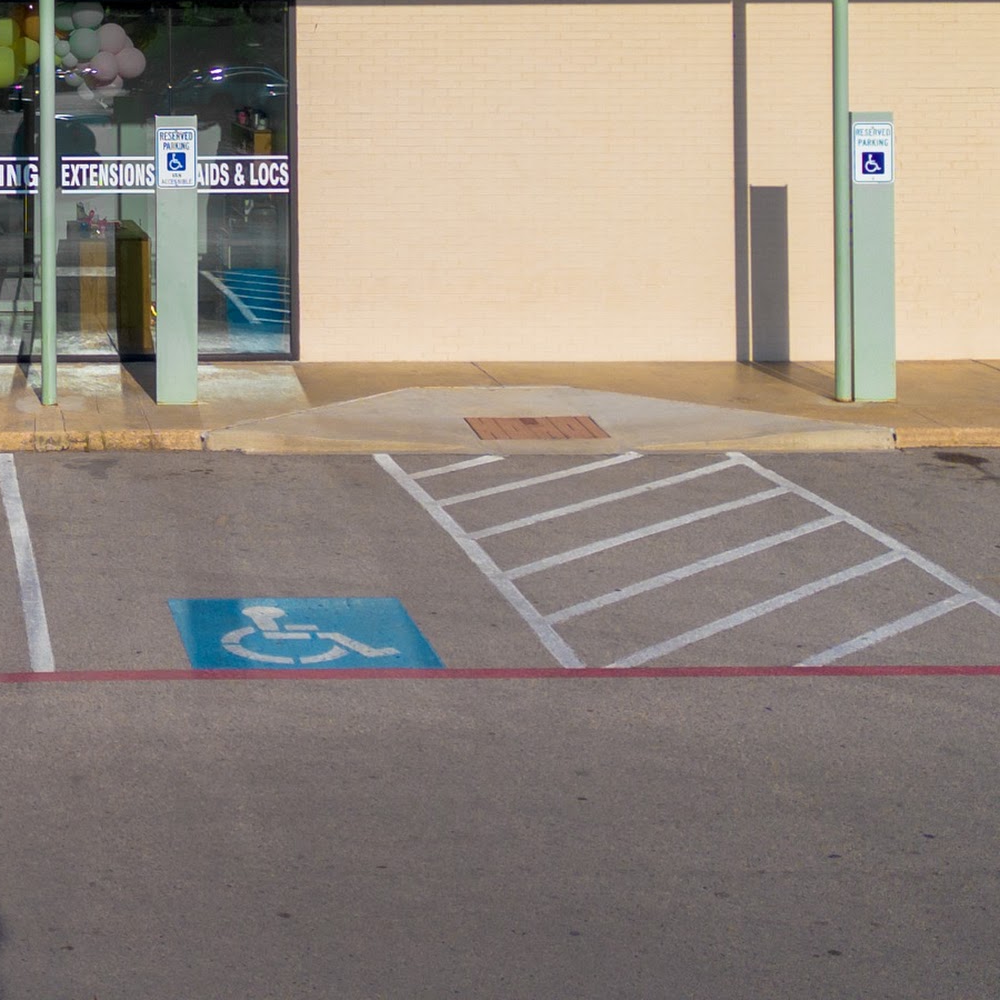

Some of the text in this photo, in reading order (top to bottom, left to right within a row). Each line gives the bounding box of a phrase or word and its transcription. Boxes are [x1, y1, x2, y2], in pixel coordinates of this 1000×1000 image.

[159, 131, 193, 141] RESERVED
[856, 128, 891, 136] RESERVED
[163, 141, 190, 150] PARKING
[858, 138, 889, 146] PARKING
[61, 163, 155, 187] EXTENSIONS
[234, 163, 245, 186] &
[250, 162, 289, 186] LOCS
